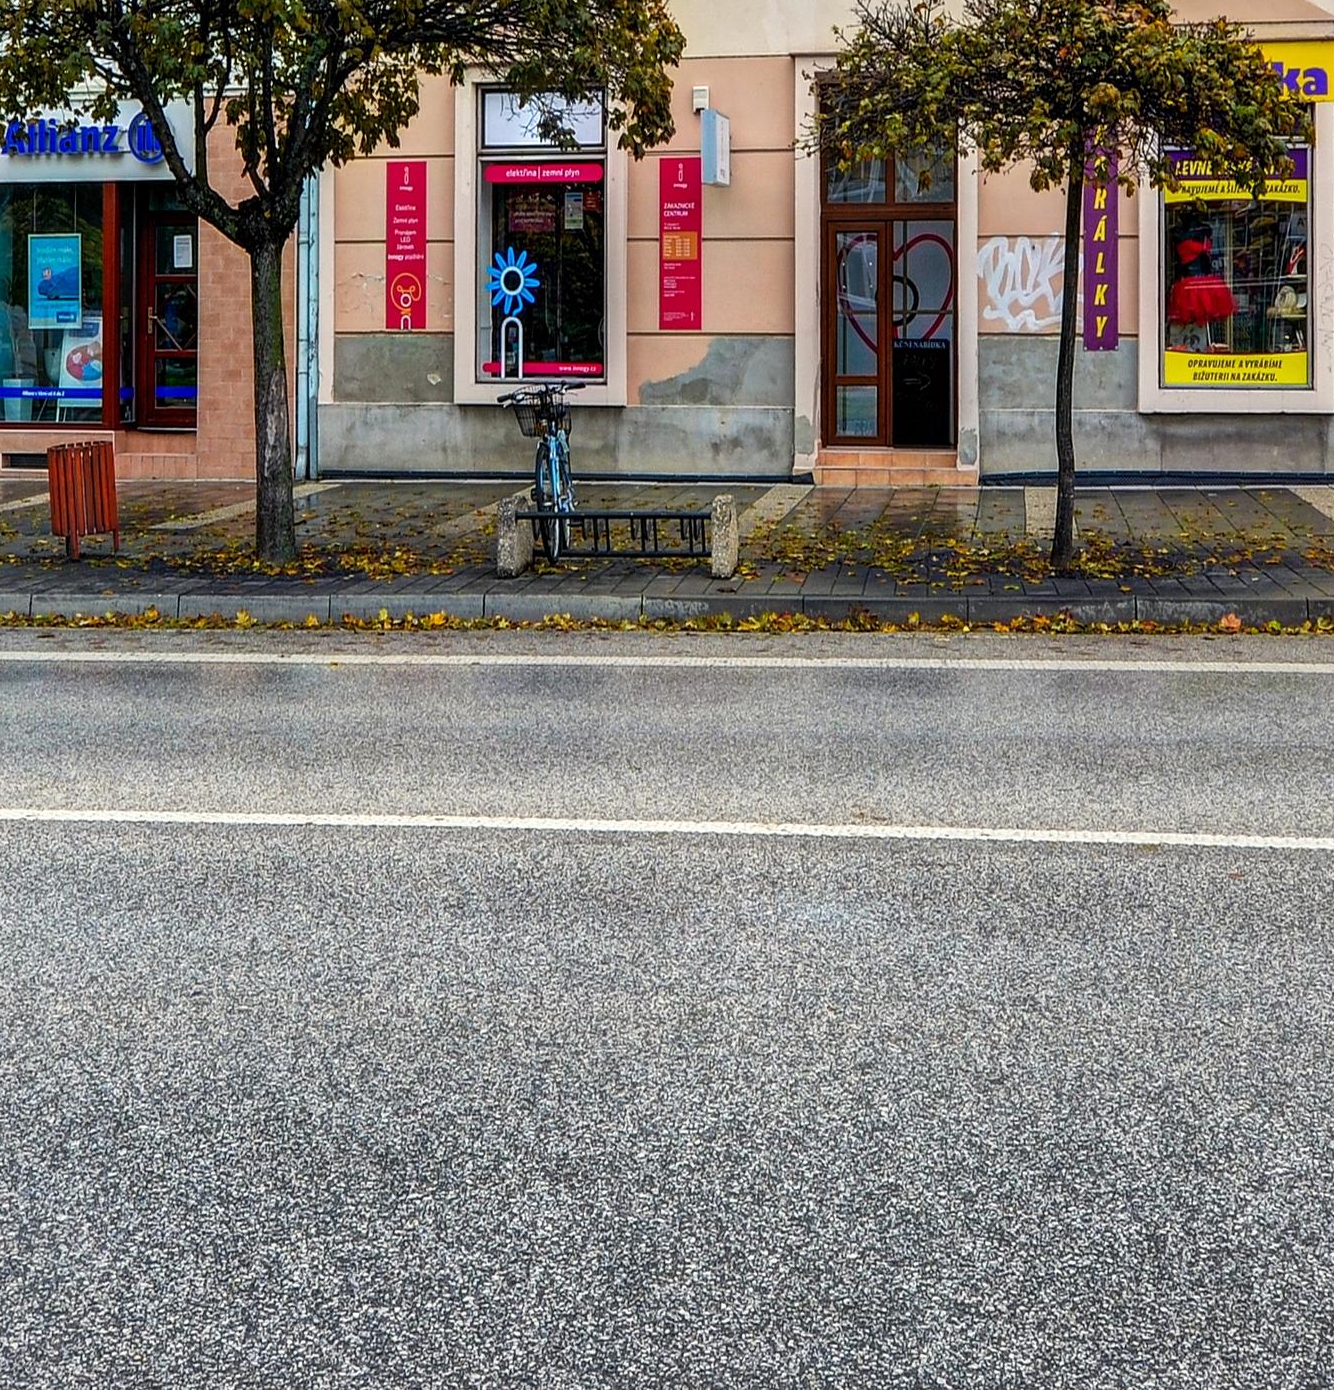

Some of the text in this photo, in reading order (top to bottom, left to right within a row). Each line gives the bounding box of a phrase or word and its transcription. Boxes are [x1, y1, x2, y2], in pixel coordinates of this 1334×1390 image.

[1270, 61, 1328, 96] ka
[1, 118, 119, 155] Allianz
[506, 168, 580, 179] elektřina zemní plyn
[1187, 358, 1282, 369] OPRAVUJEME A VYRÁBÍME
[1193, 370, 1277, 381] BIŽUTERII NA ZAKÁZKU.
